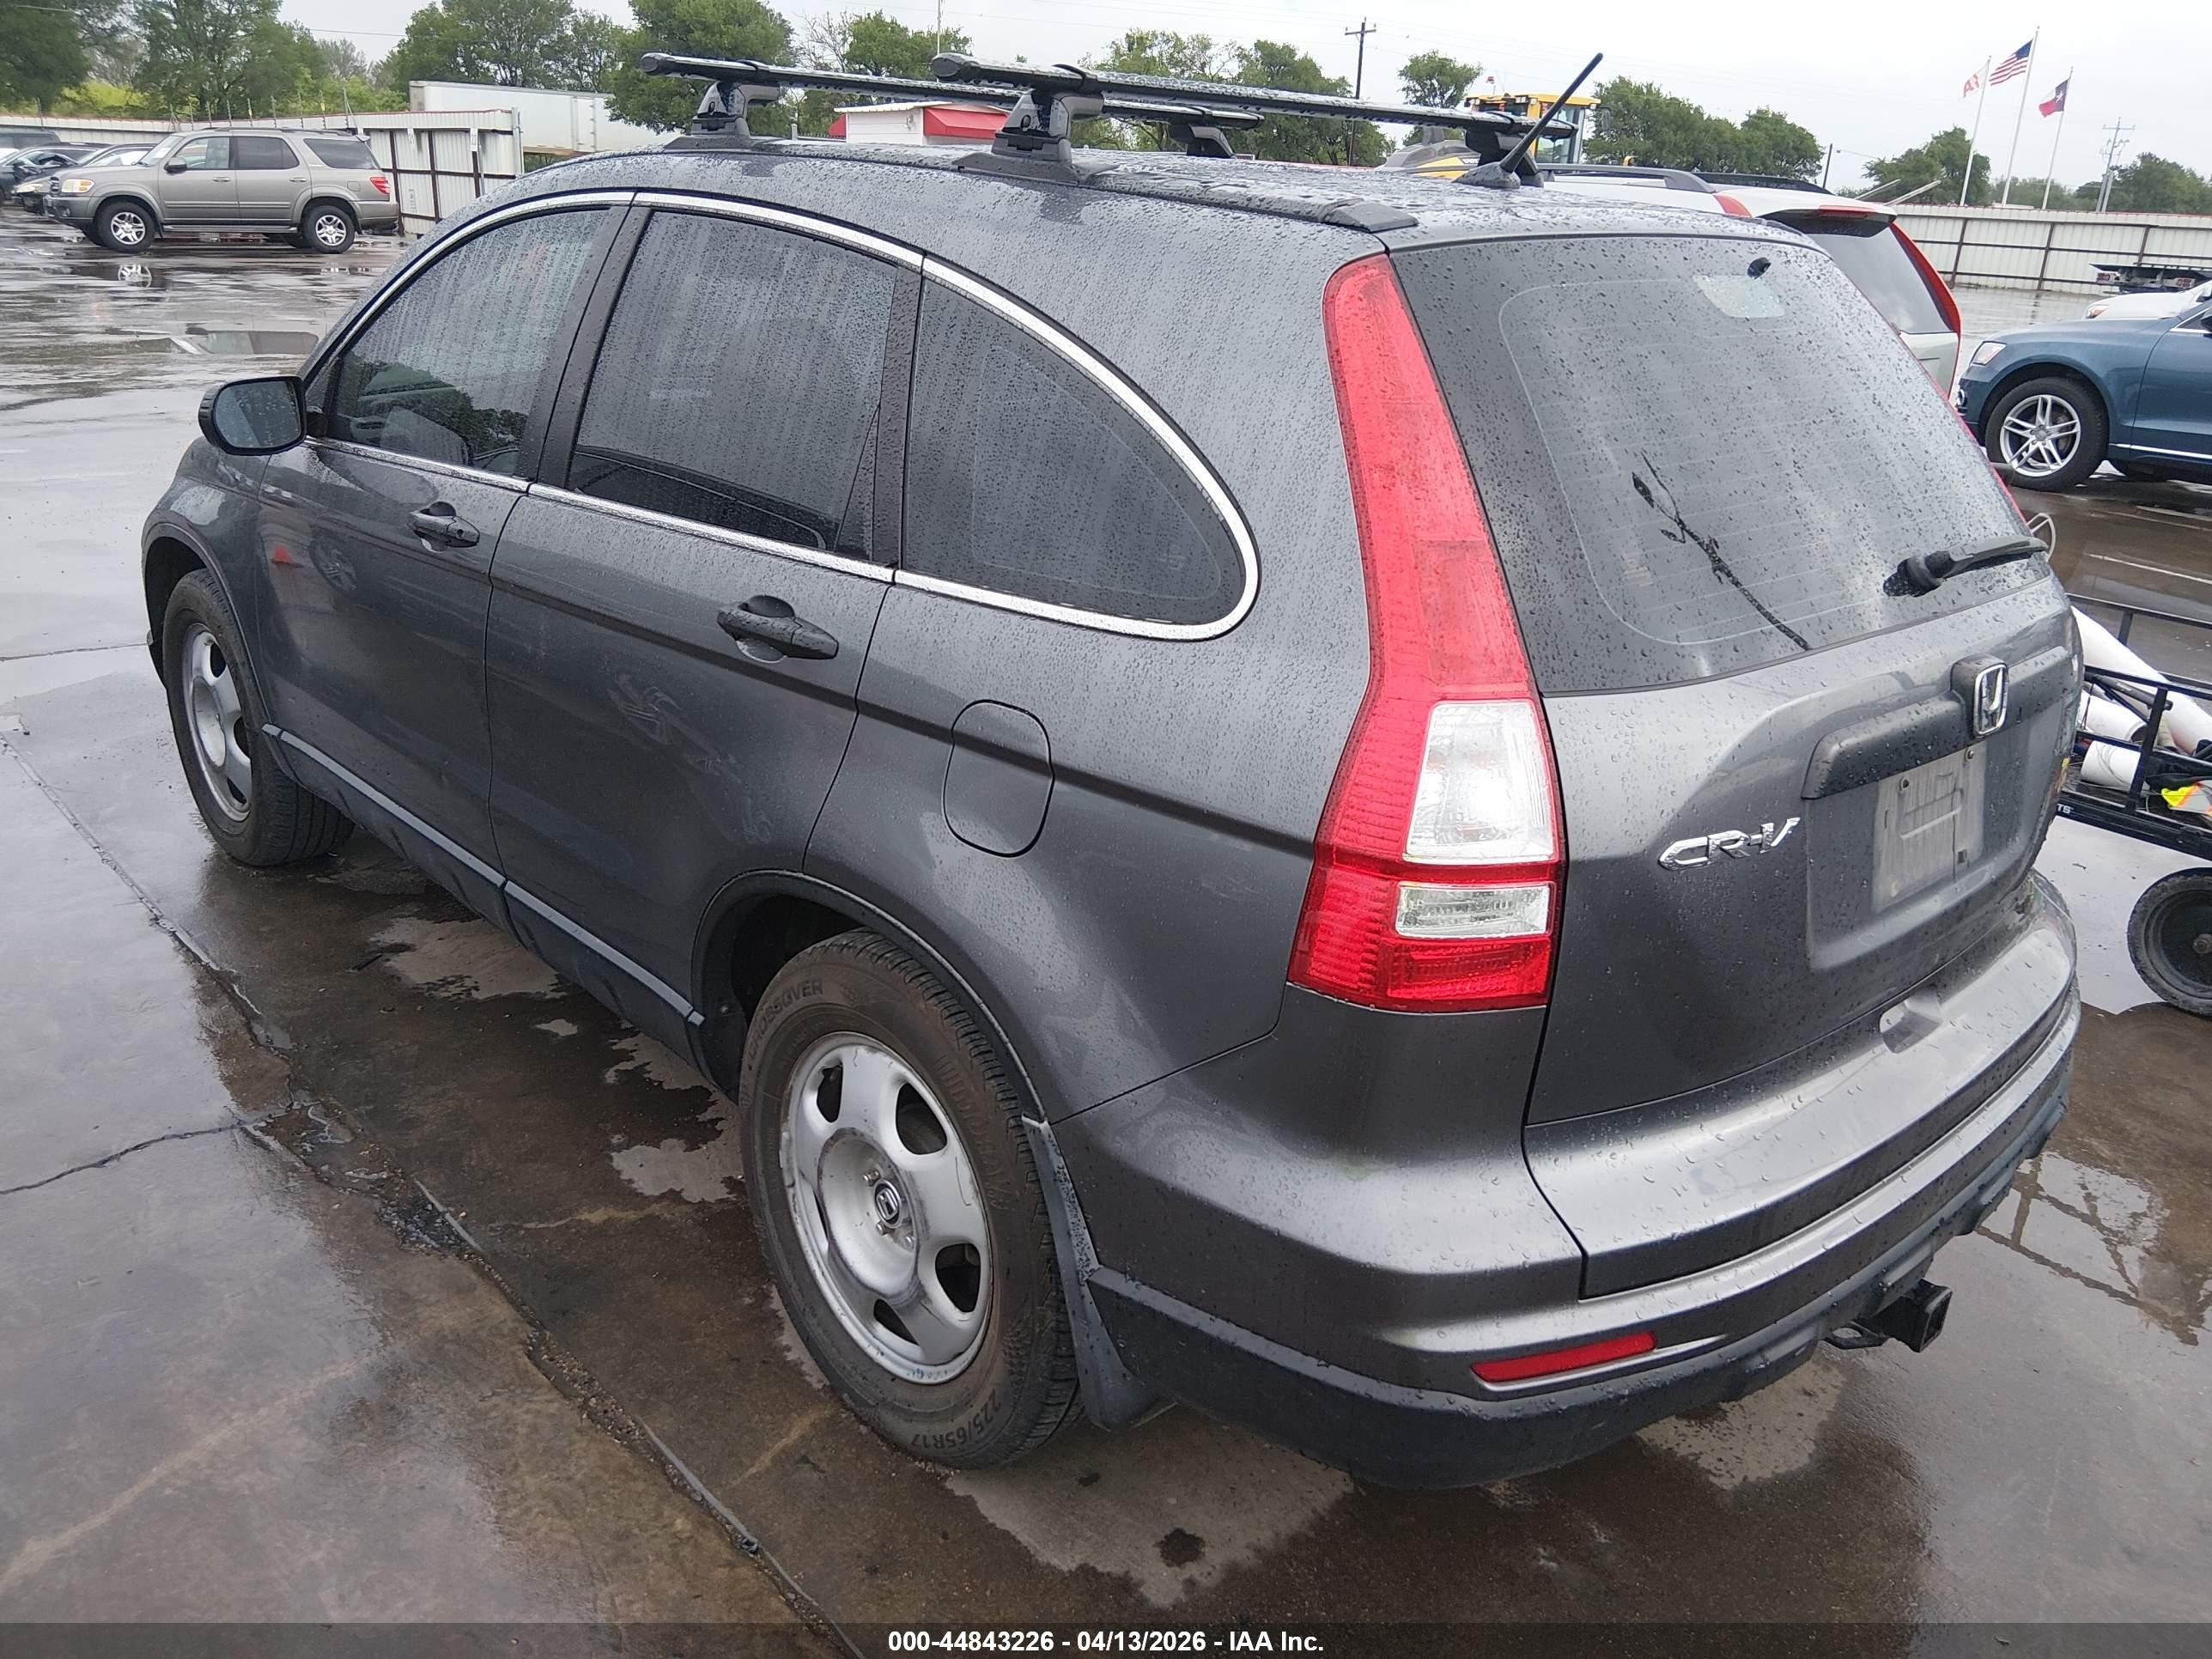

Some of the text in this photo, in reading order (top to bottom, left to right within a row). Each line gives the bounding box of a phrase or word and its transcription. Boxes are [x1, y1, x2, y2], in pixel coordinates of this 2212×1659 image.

[1658, 817, 1802, 870] CR-V
[748, 978, 824, 1060] CROSSOVER
[911, 1387, 1002, 1450] 225/65R17
